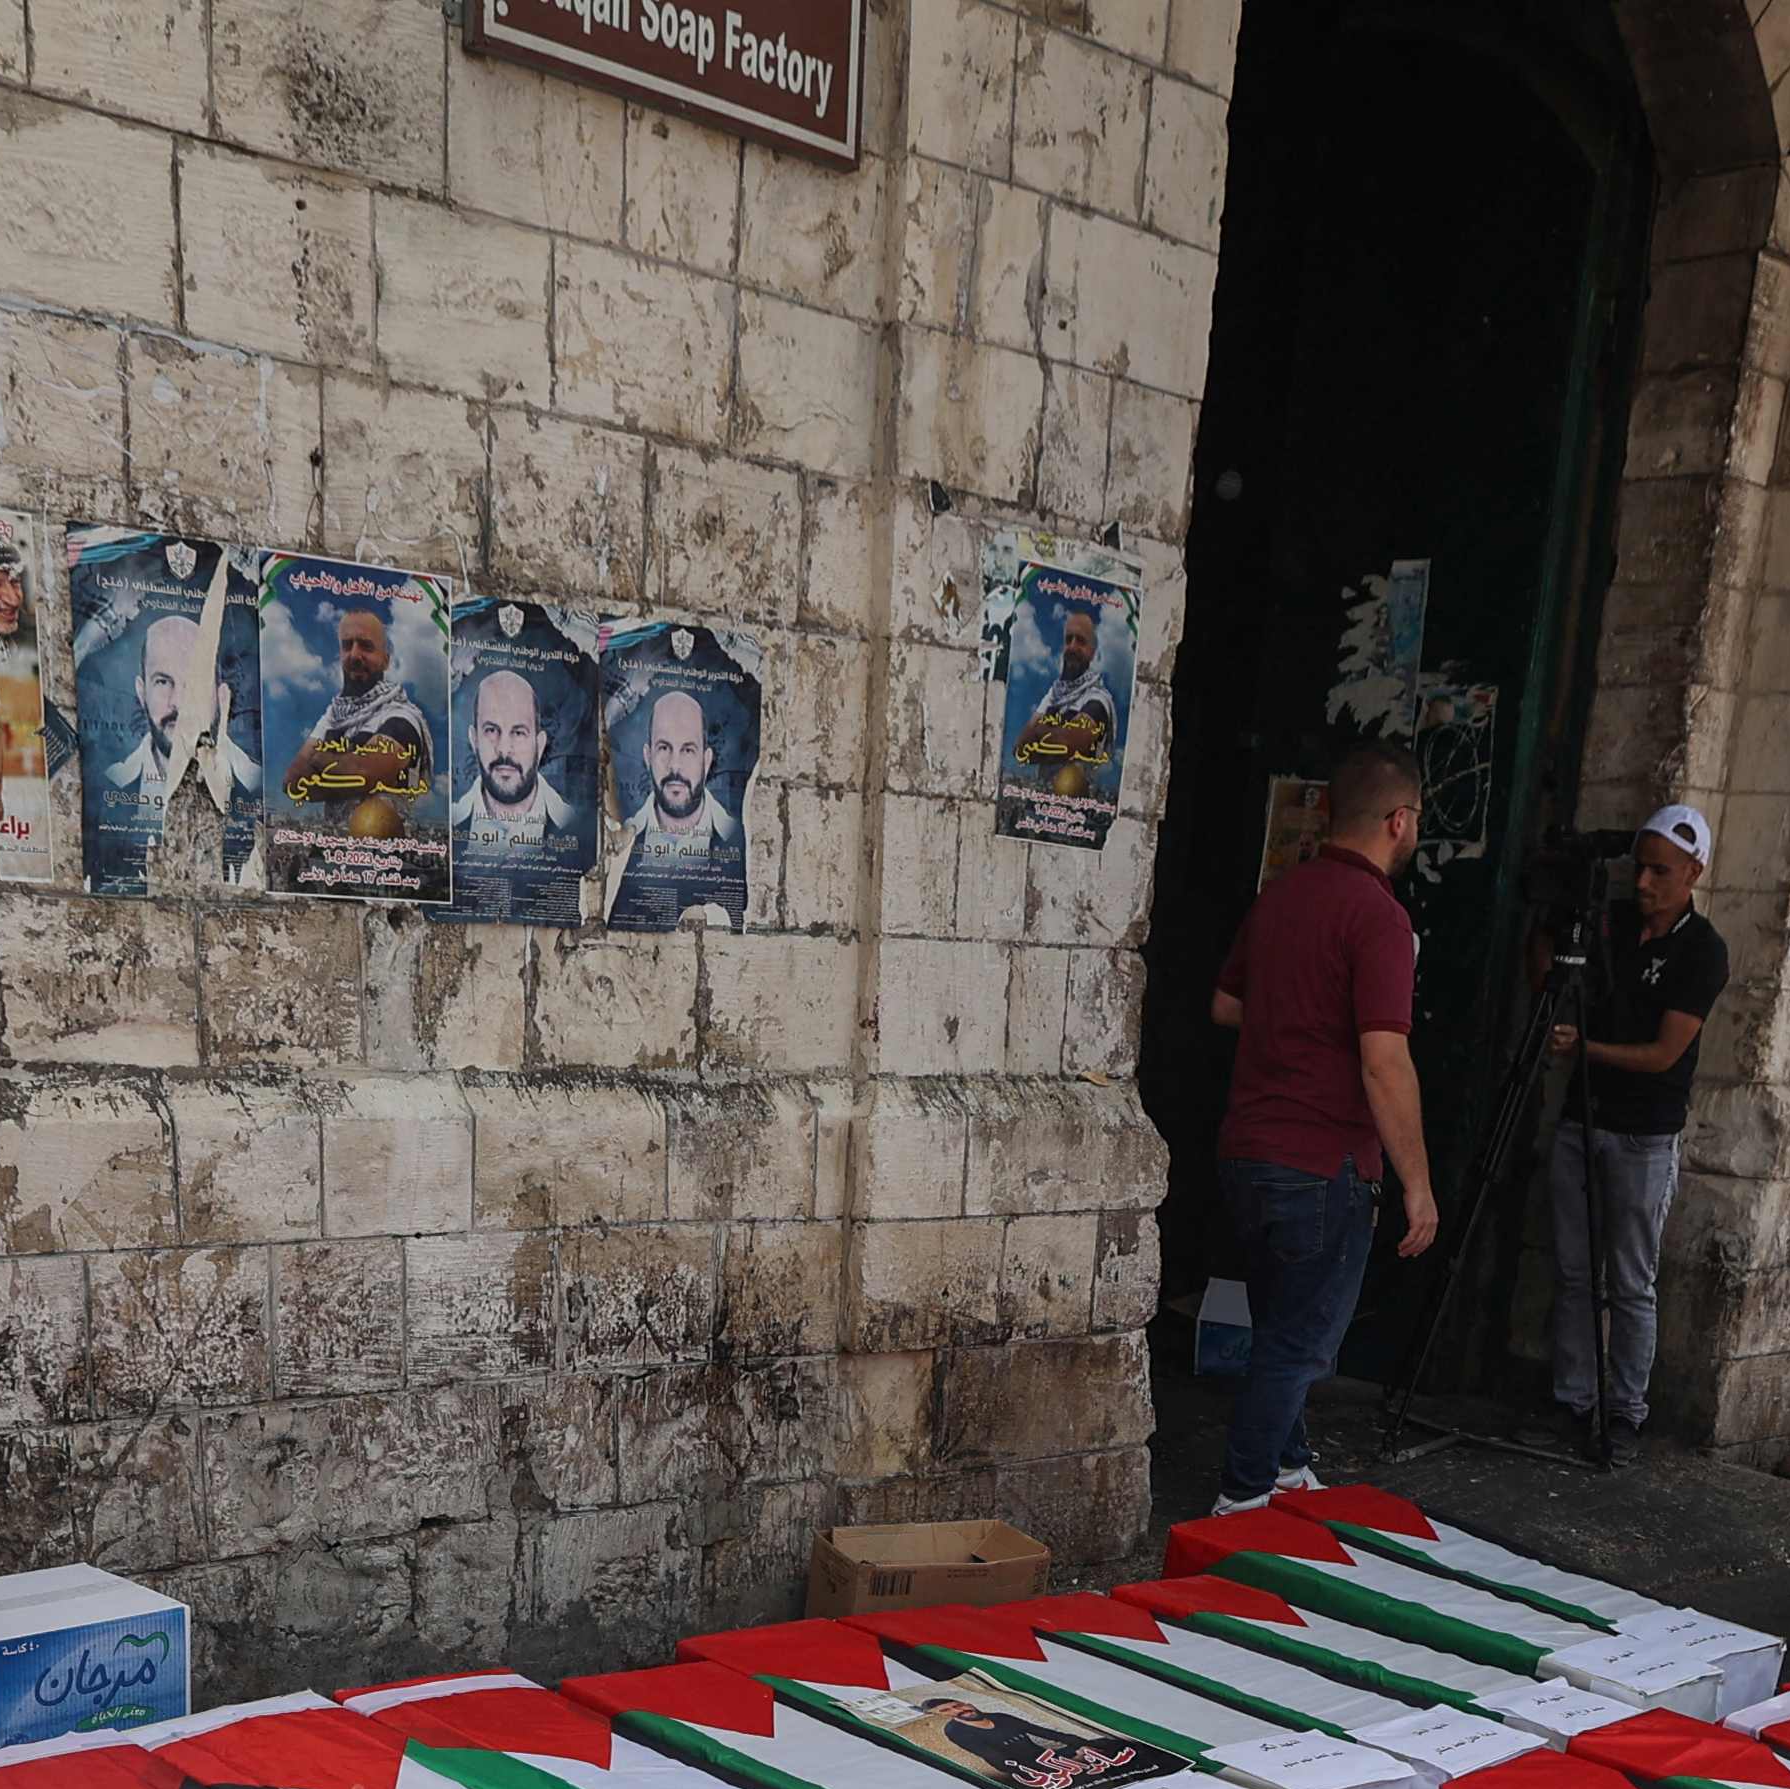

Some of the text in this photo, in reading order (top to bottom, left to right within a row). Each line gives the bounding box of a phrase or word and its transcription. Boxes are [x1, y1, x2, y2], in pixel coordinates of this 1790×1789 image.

[640, 0, 714, 75] Soap
[724, 9, 833, 119] Factory
[96, 572, 129, 590] (فتح)
[287, 761, 429, 807] هيثم كعبي
[509, 831, 547, 849] مسلم
[678, 843, 710, 858] مسلم
[34, 1649, 157, 1709] مرجان
